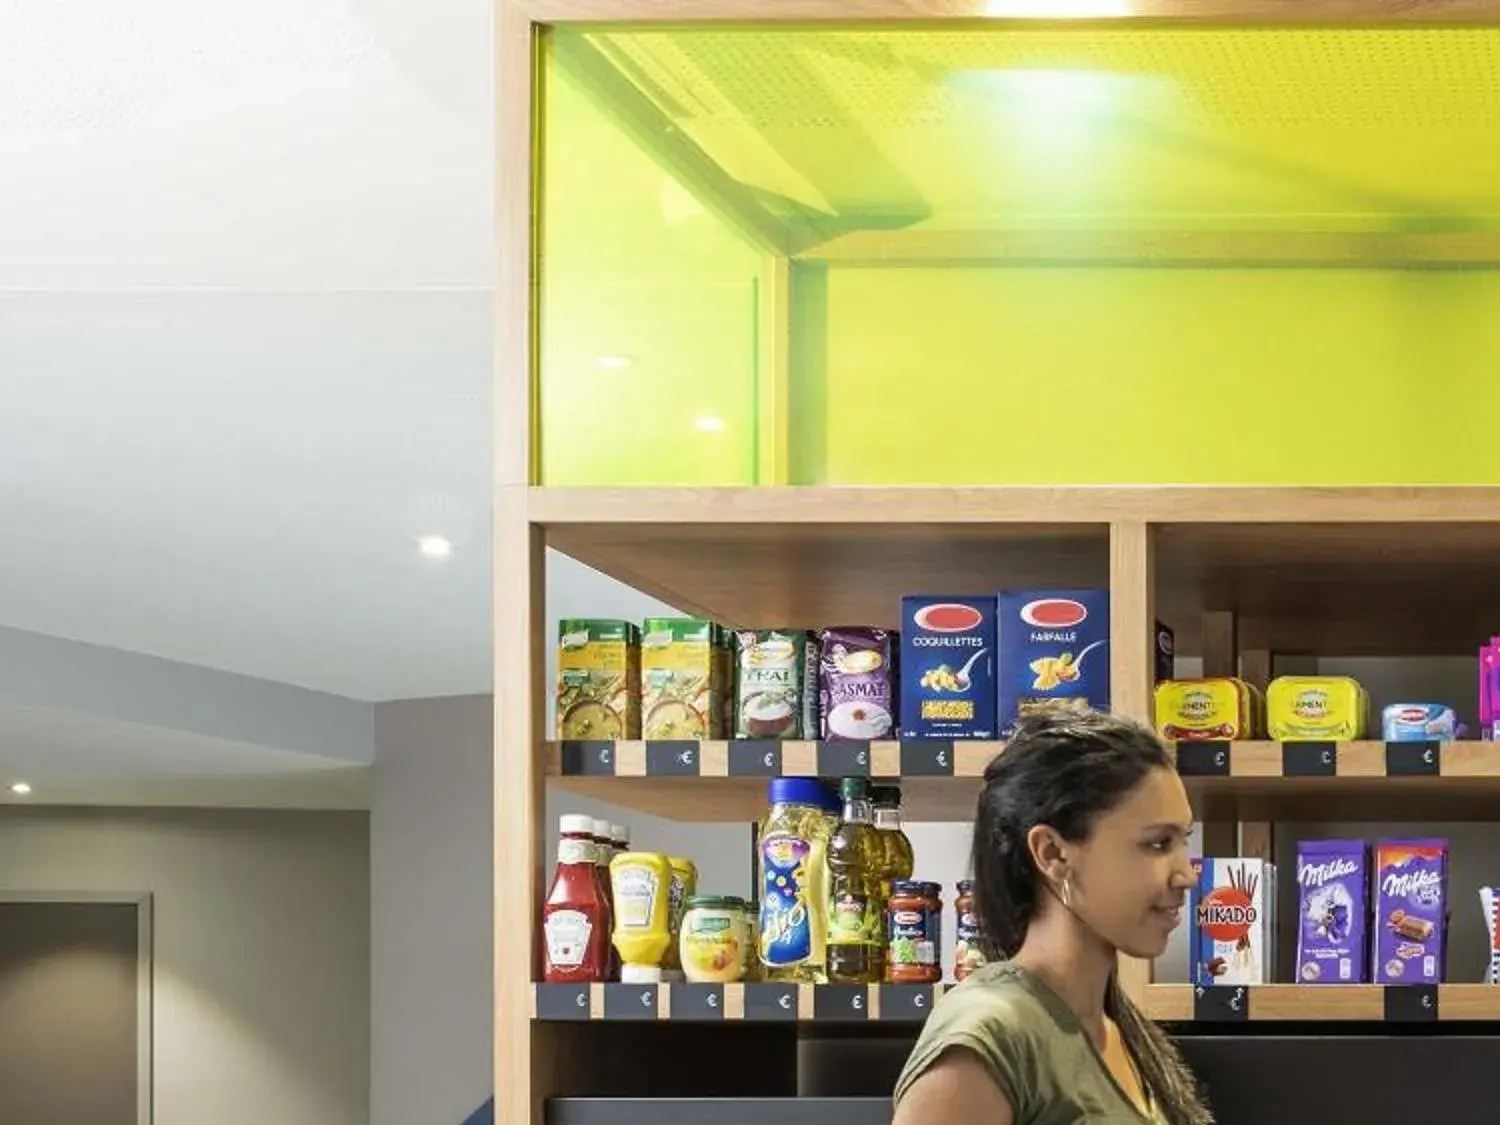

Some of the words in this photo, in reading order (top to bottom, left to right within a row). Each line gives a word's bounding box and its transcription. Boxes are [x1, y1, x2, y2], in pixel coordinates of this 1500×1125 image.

[912, 636, 983, 647] COQUILLETTES
[1030, 631, 1077, 642] FARFALLE
[1299, 857, 1359, 887] Milka
[1383, 869, 1442, 897] Milka
[1196, 907, 1258, 923] MIKADO
